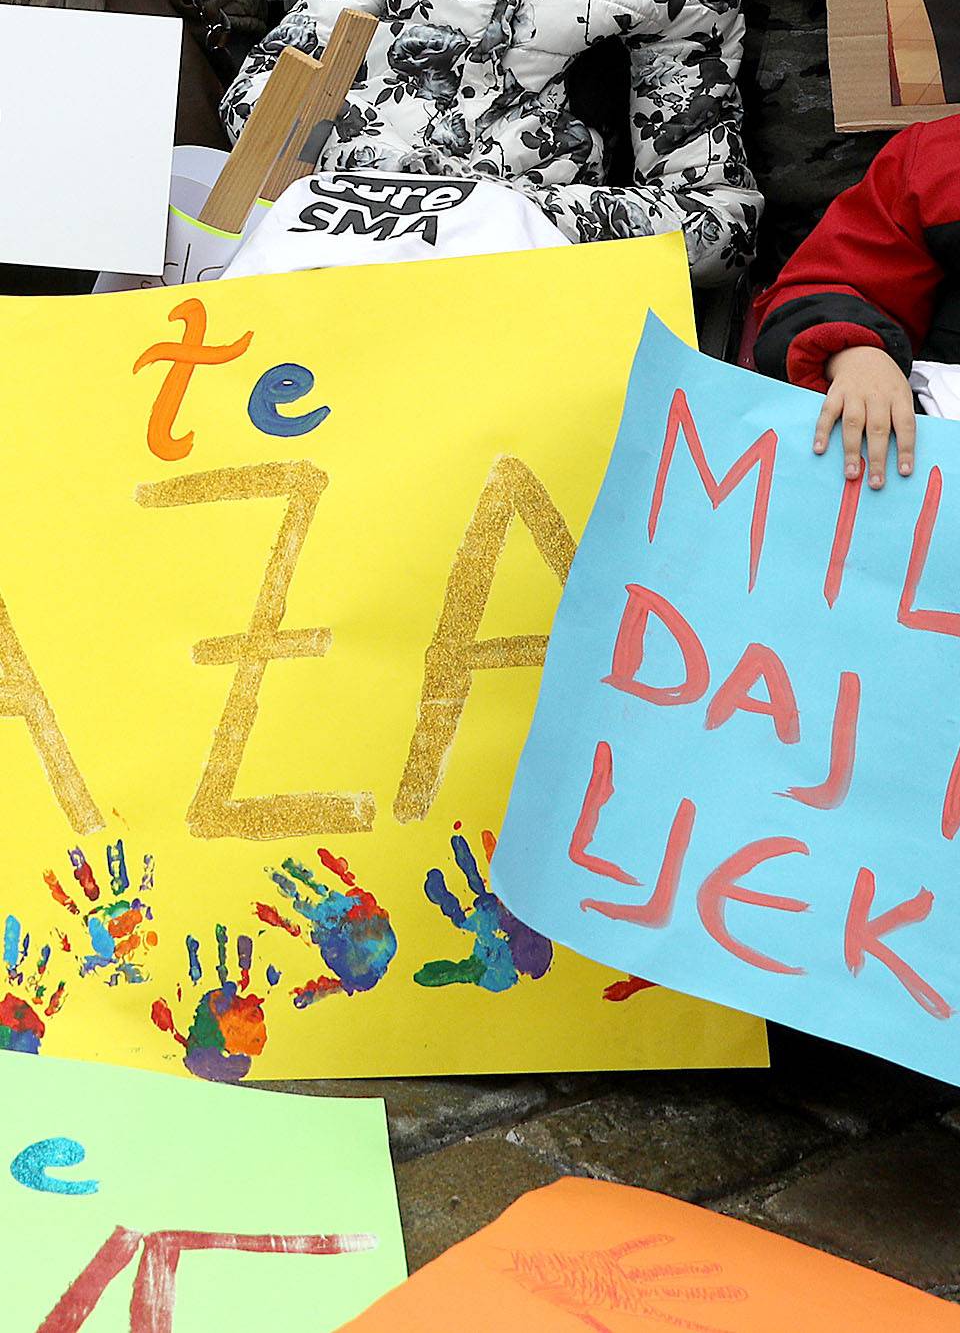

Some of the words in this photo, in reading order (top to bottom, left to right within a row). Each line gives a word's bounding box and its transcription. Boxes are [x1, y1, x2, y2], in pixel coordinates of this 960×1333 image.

[287, 201, 439, 247] SMA
[600, 583, 862, 812] DAJ
[567, 740, 959, 1023] LJEK
